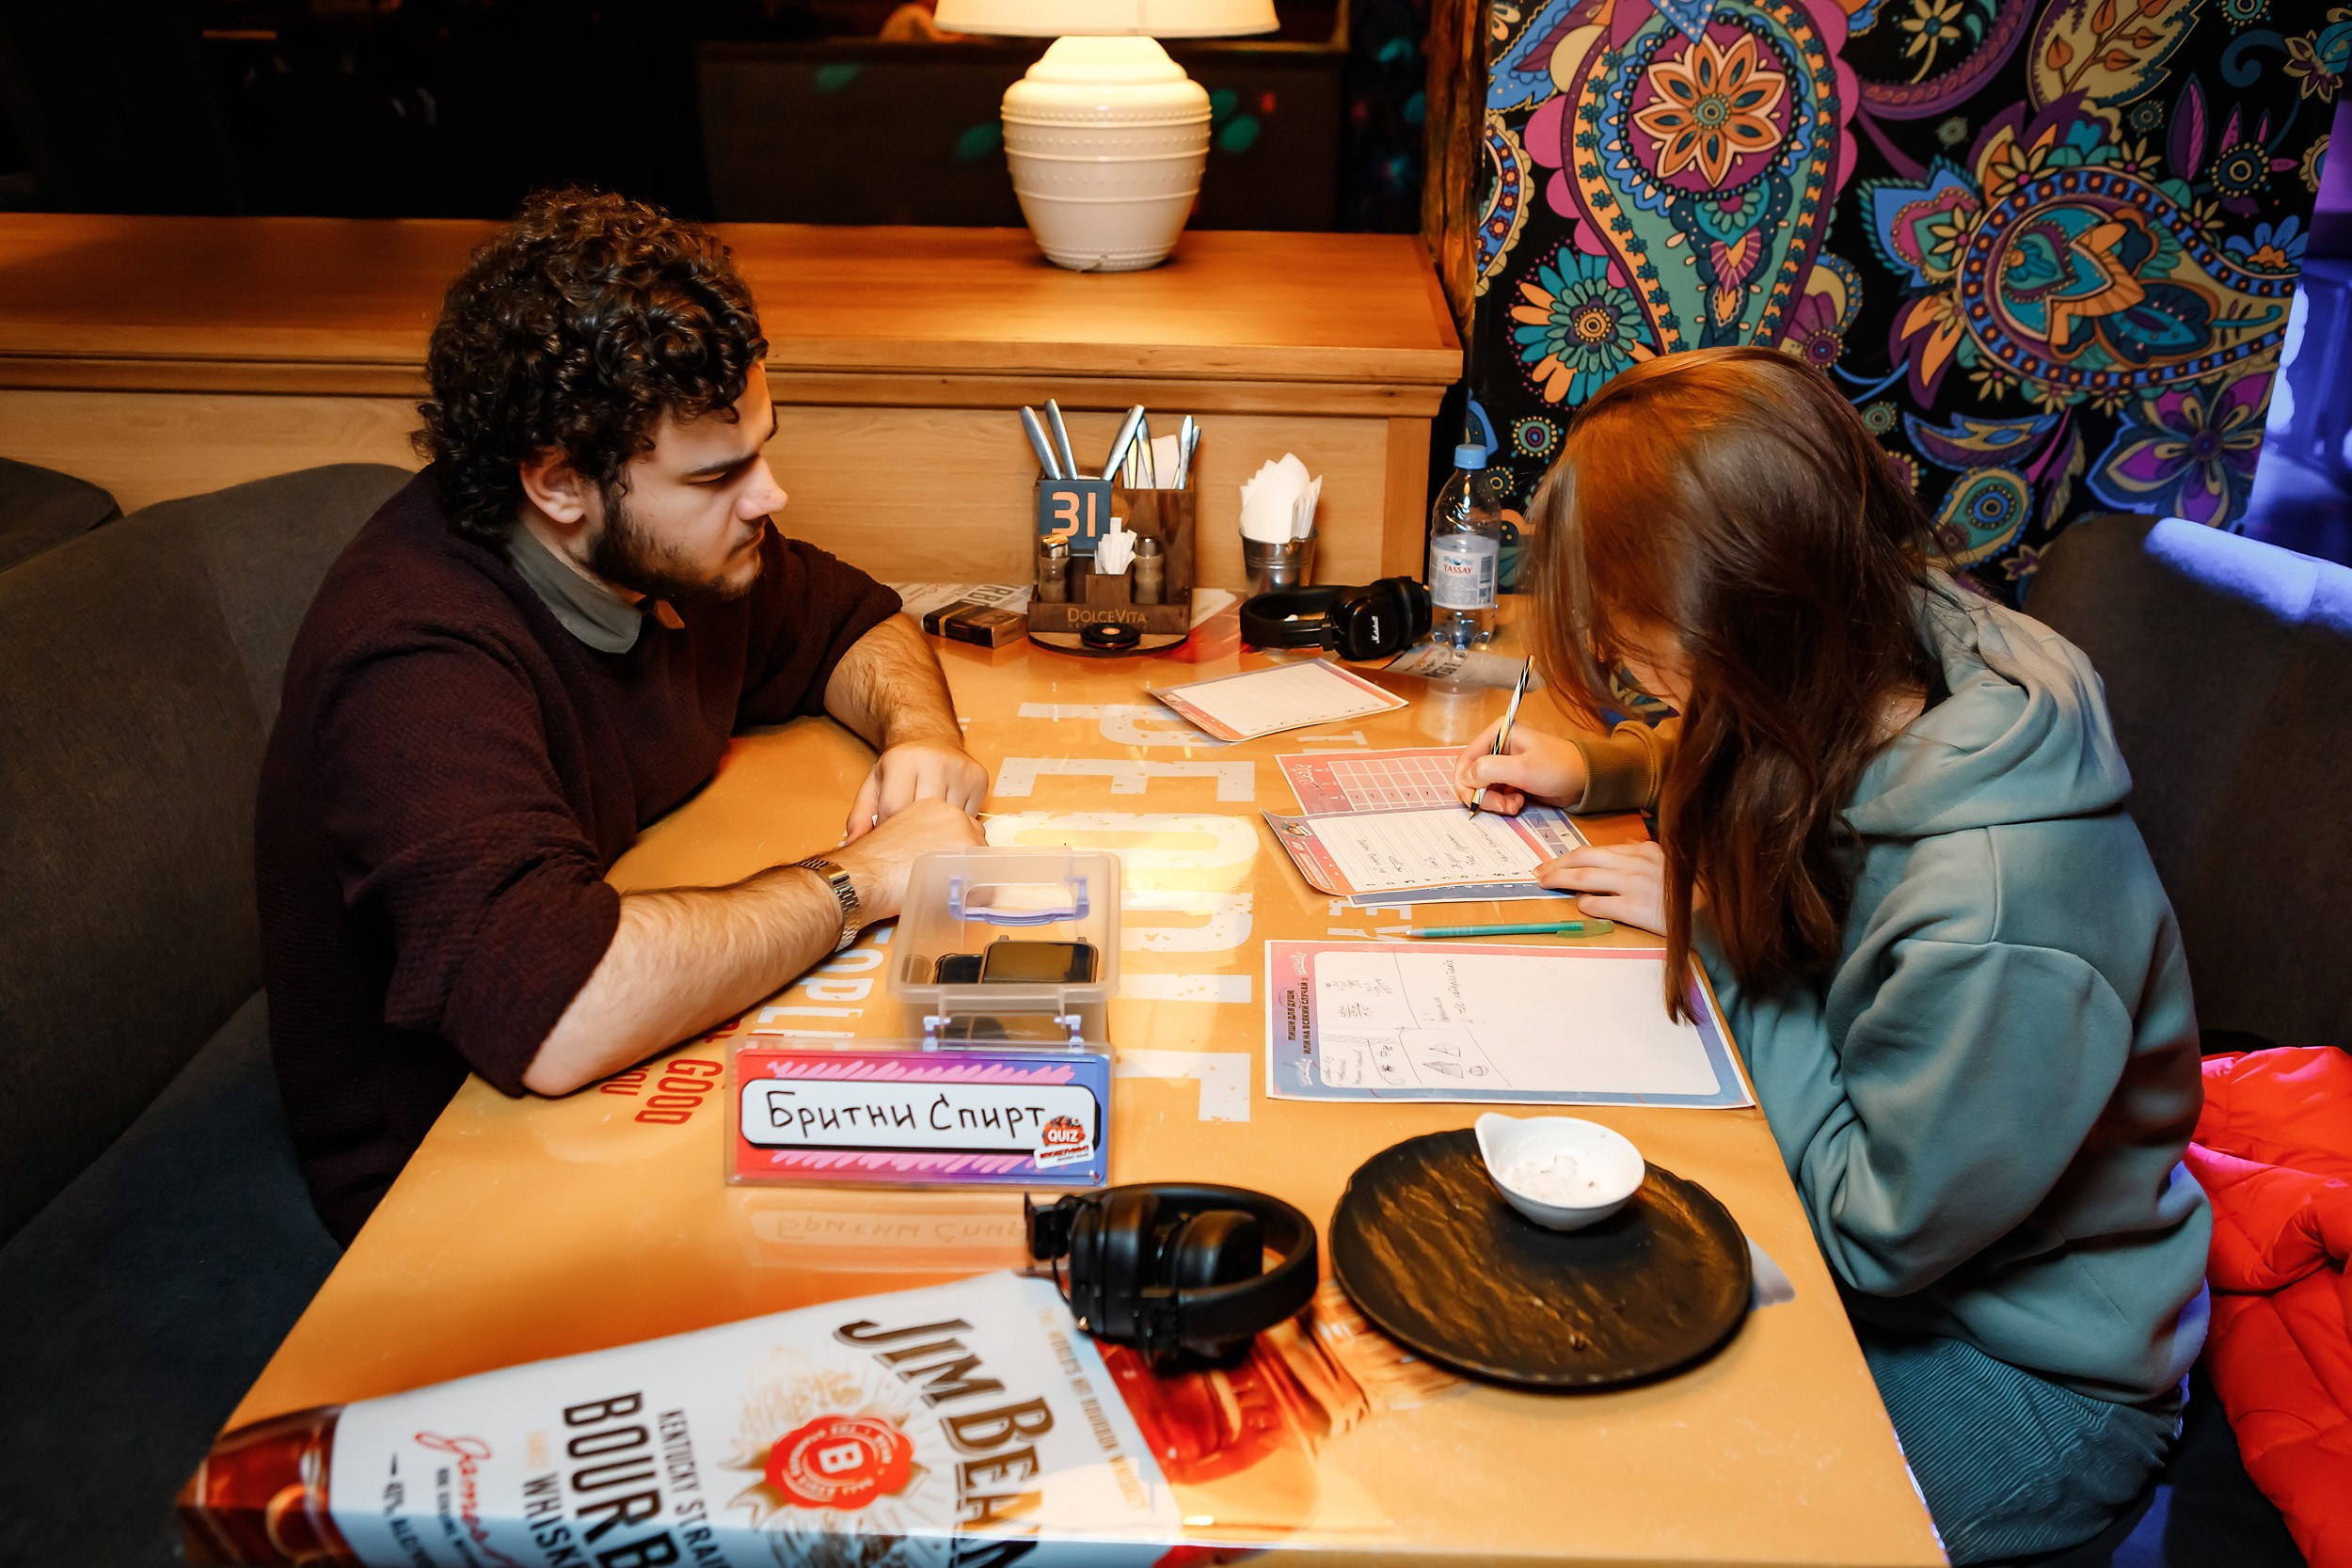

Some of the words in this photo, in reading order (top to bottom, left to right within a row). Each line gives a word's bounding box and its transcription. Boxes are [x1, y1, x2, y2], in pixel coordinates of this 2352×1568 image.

[1051, 491, 1096, 538] 31
[1443, 564, 1473, 575] TASSAY
[1286, 990, 1295, 1007] ДУШИ
[1298, 983, 1310, 1006] СЛУЧАЙ
[1287, 1007, 1296, 1022] ДЛЯ
[1299, 1006, 1311, 1030] ВСЯКИЙ
[1287, 1022, 1296, 1041] ПИШИ
[1302, 1040, 1311, 1054] ИЛИ
[634, 1059, 723, 1125] GOOD
[1047, 1129, 1079, 1143] QUIZ
[833, 1318, 1007, 1409] JIM
[660, 1408, 701, 1493] KENTUCKY
[818, 1441, 865, 1474] B
[521, 1471, 593, 1568] WHISK
